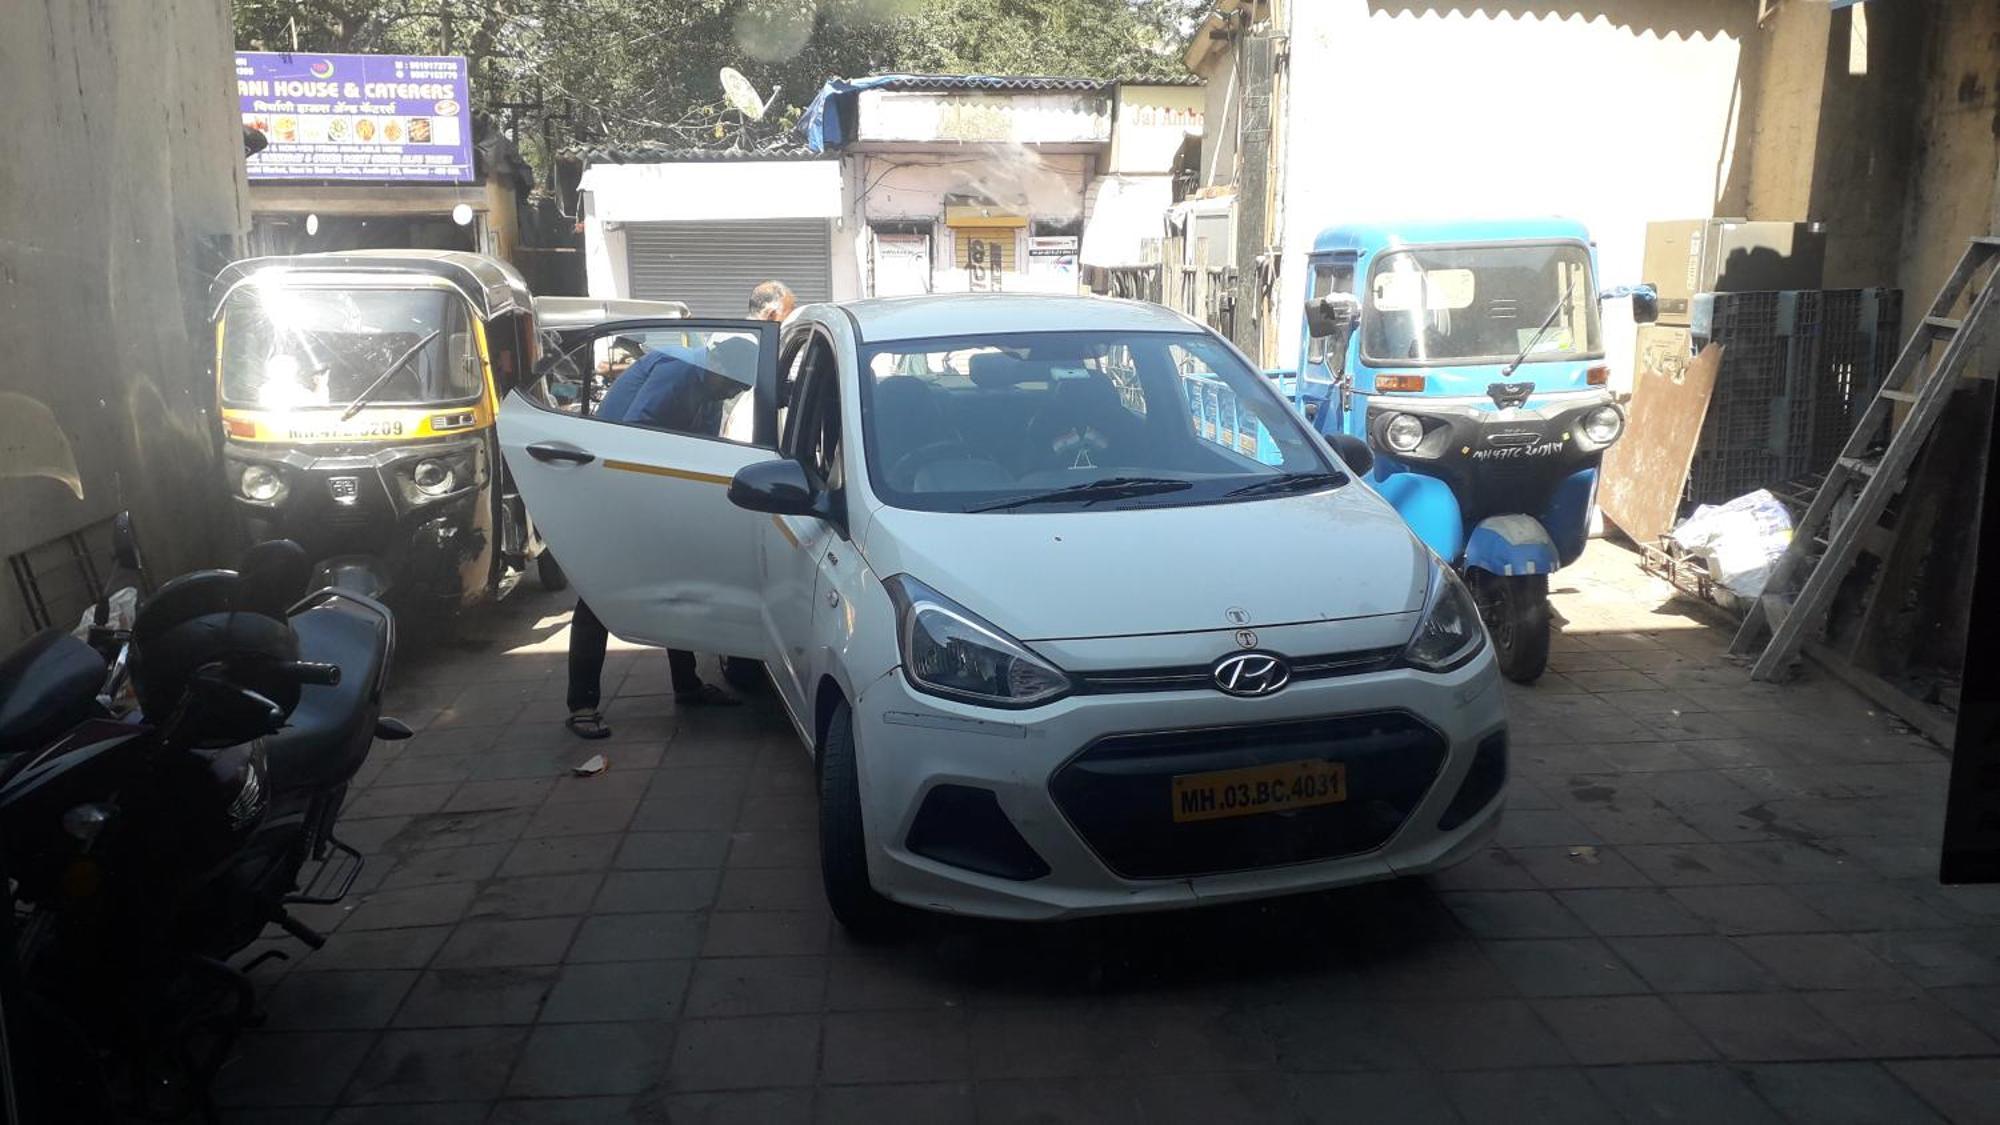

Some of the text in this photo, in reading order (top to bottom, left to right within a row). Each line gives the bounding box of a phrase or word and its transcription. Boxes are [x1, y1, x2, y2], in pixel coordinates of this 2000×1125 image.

[275, 81, 339, 98] HOUSE
[343, 82, 360, 98] &
[365, 82, 455, 100] CATERERS
[1181, 773, 1339, 814] MH.03.BC.4031
